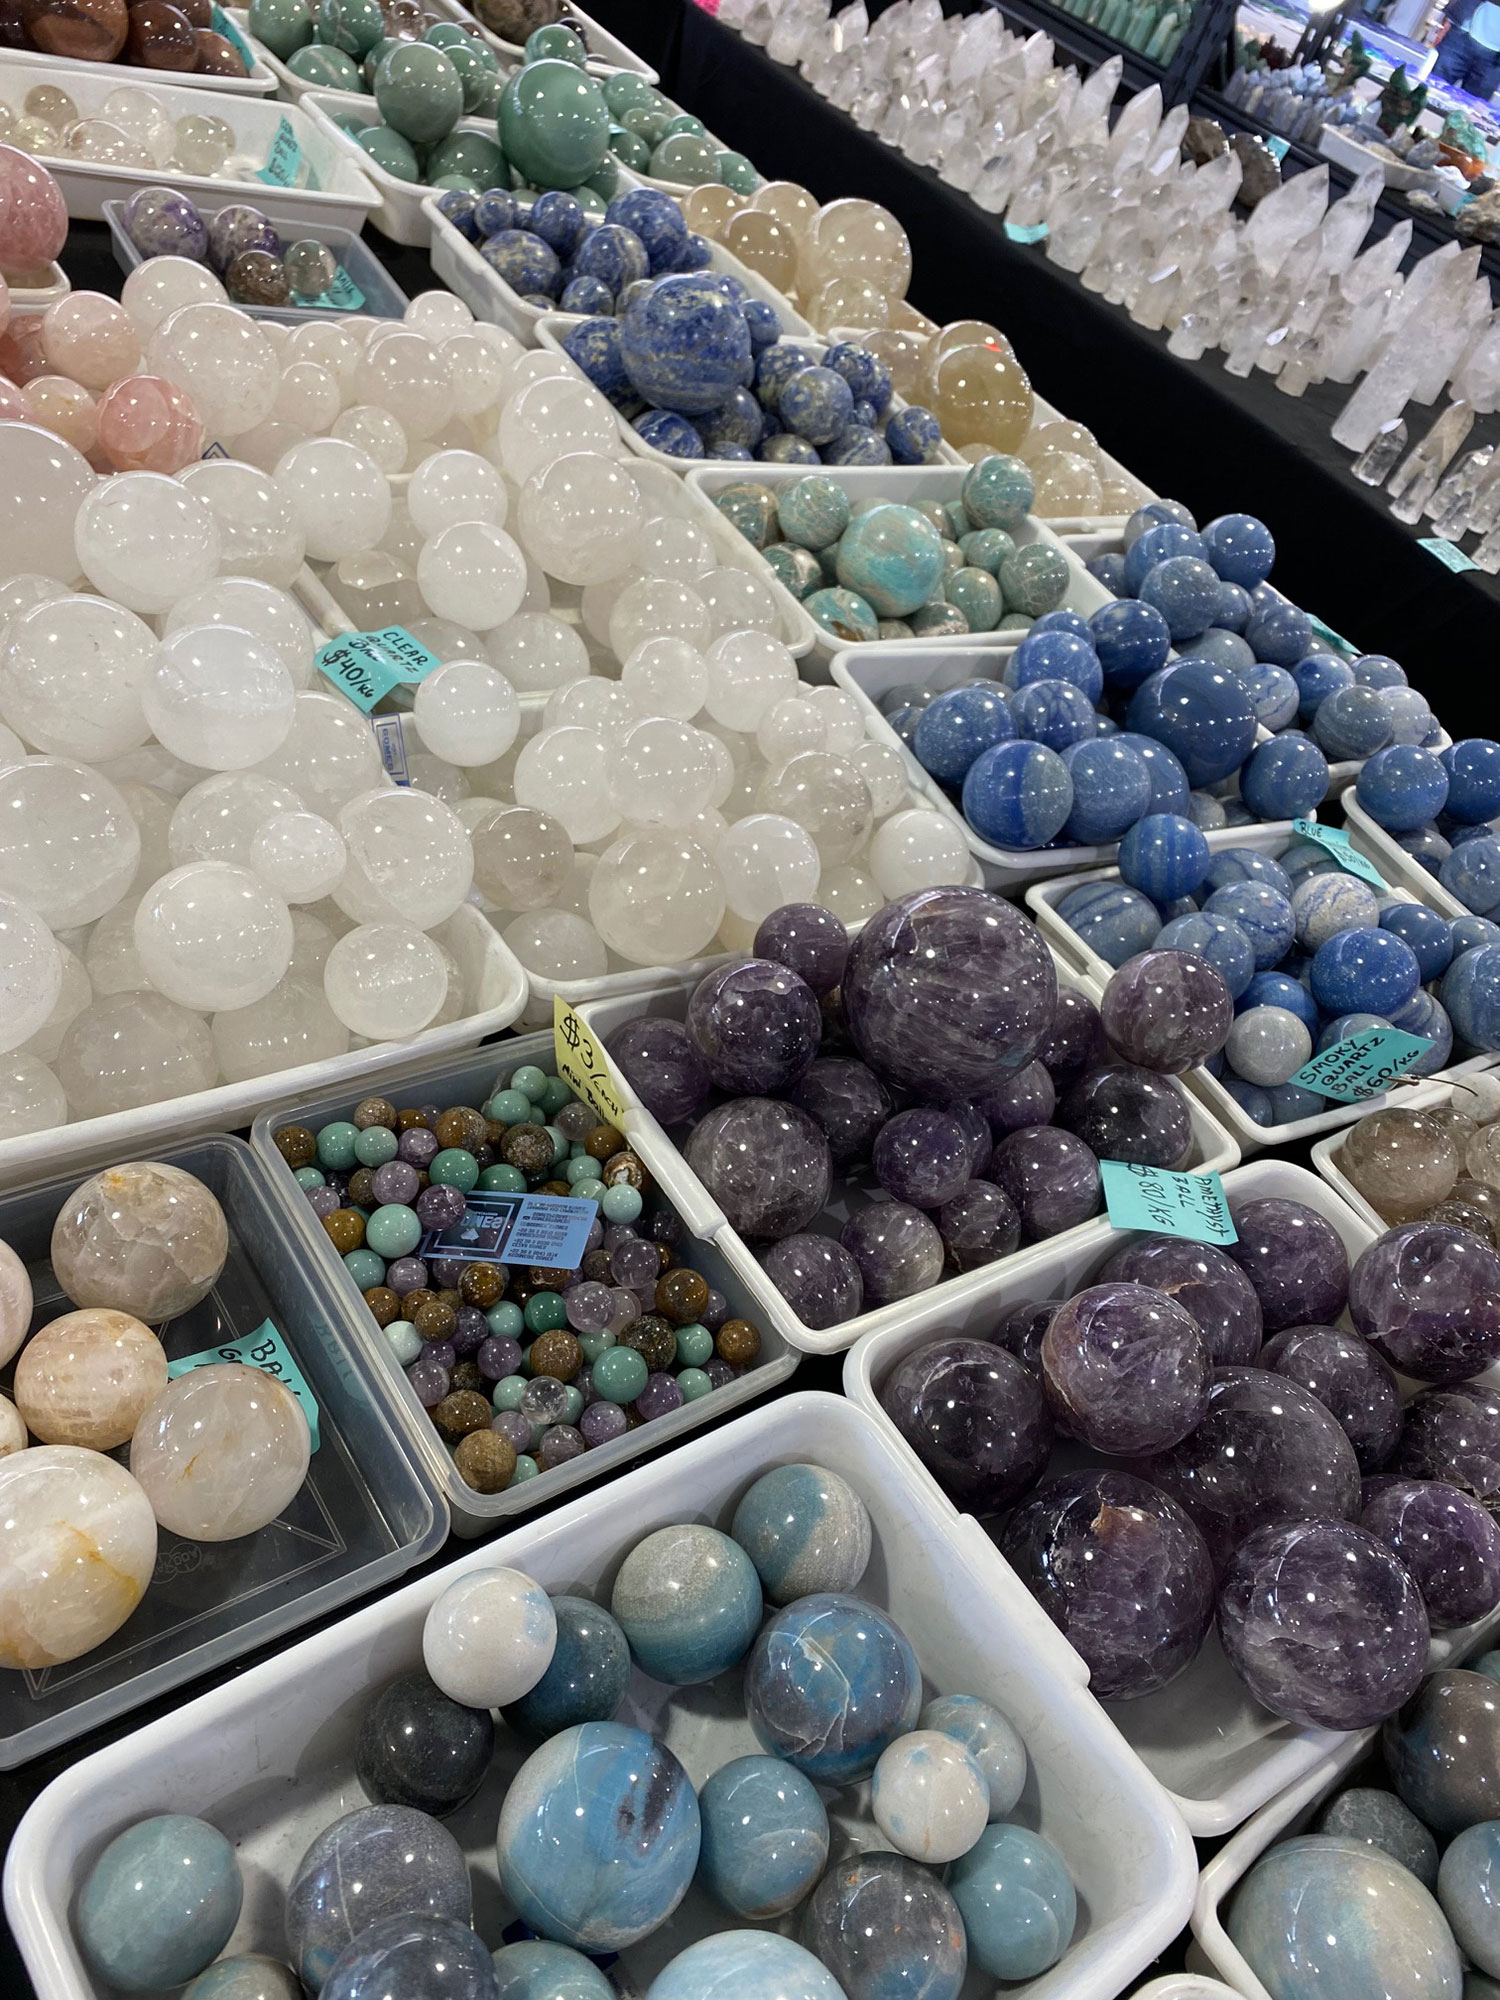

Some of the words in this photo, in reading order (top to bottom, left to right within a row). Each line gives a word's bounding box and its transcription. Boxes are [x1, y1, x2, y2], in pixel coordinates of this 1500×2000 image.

[366, 635, 419, 674] QUARTZ
[383, 631, 428, 666] CLEAR
[1300, 1039, 1359, 1085] SMOKY
[1321, 1037, 1386, 1086] QUARTZ
[1331, 1063, 1374, 1095] BALL
[1171, 1175, 1196, 1208] BALL
